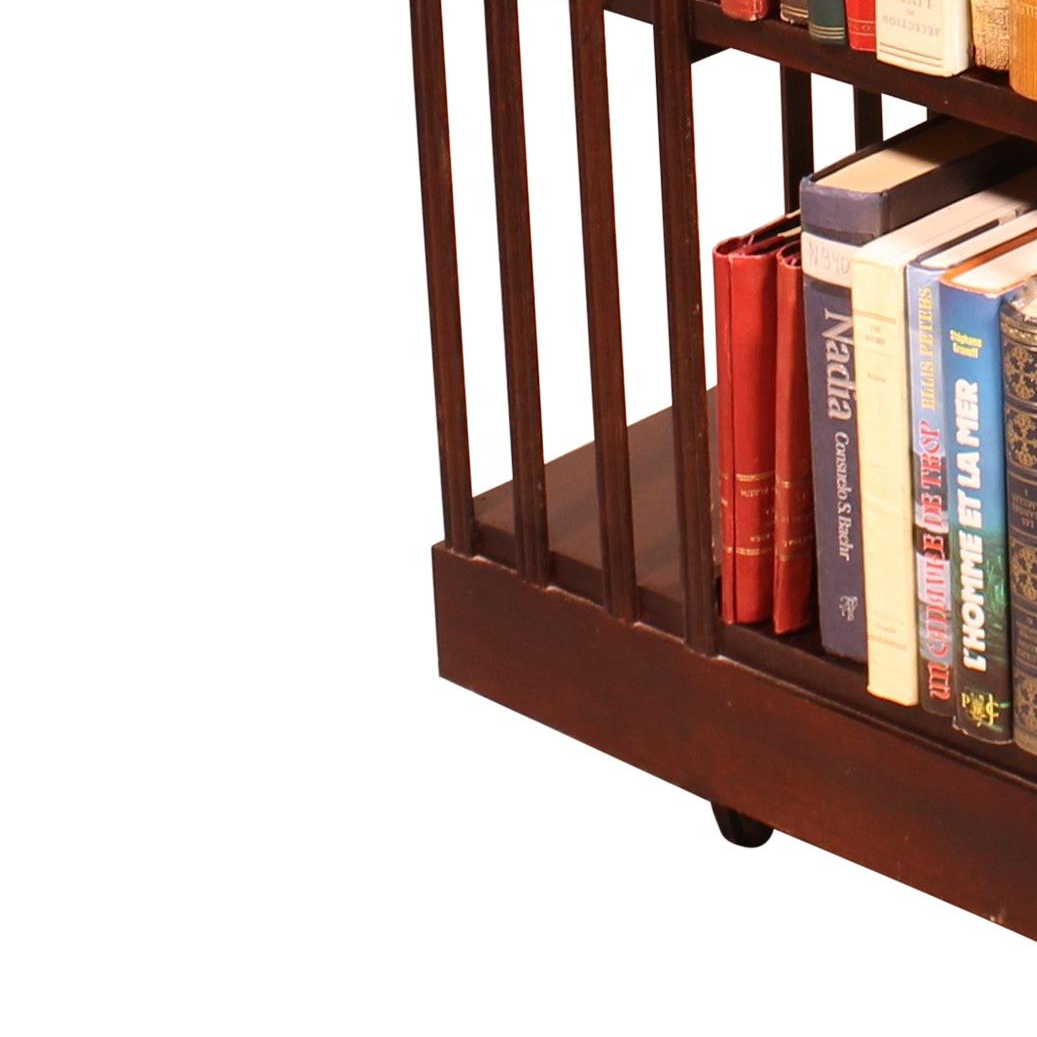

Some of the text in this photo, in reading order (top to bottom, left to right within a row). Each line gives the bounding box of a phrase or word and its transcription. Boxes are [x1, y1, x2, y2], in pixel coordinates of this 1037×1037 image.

[822, 308, 857, 421] Nadia
[918, 287, 936, 410] ELLIS PETERS
[834, 430, 852, 502] Consuelo
[954, 378, 988, 673] L'HOMME ET LA MER
